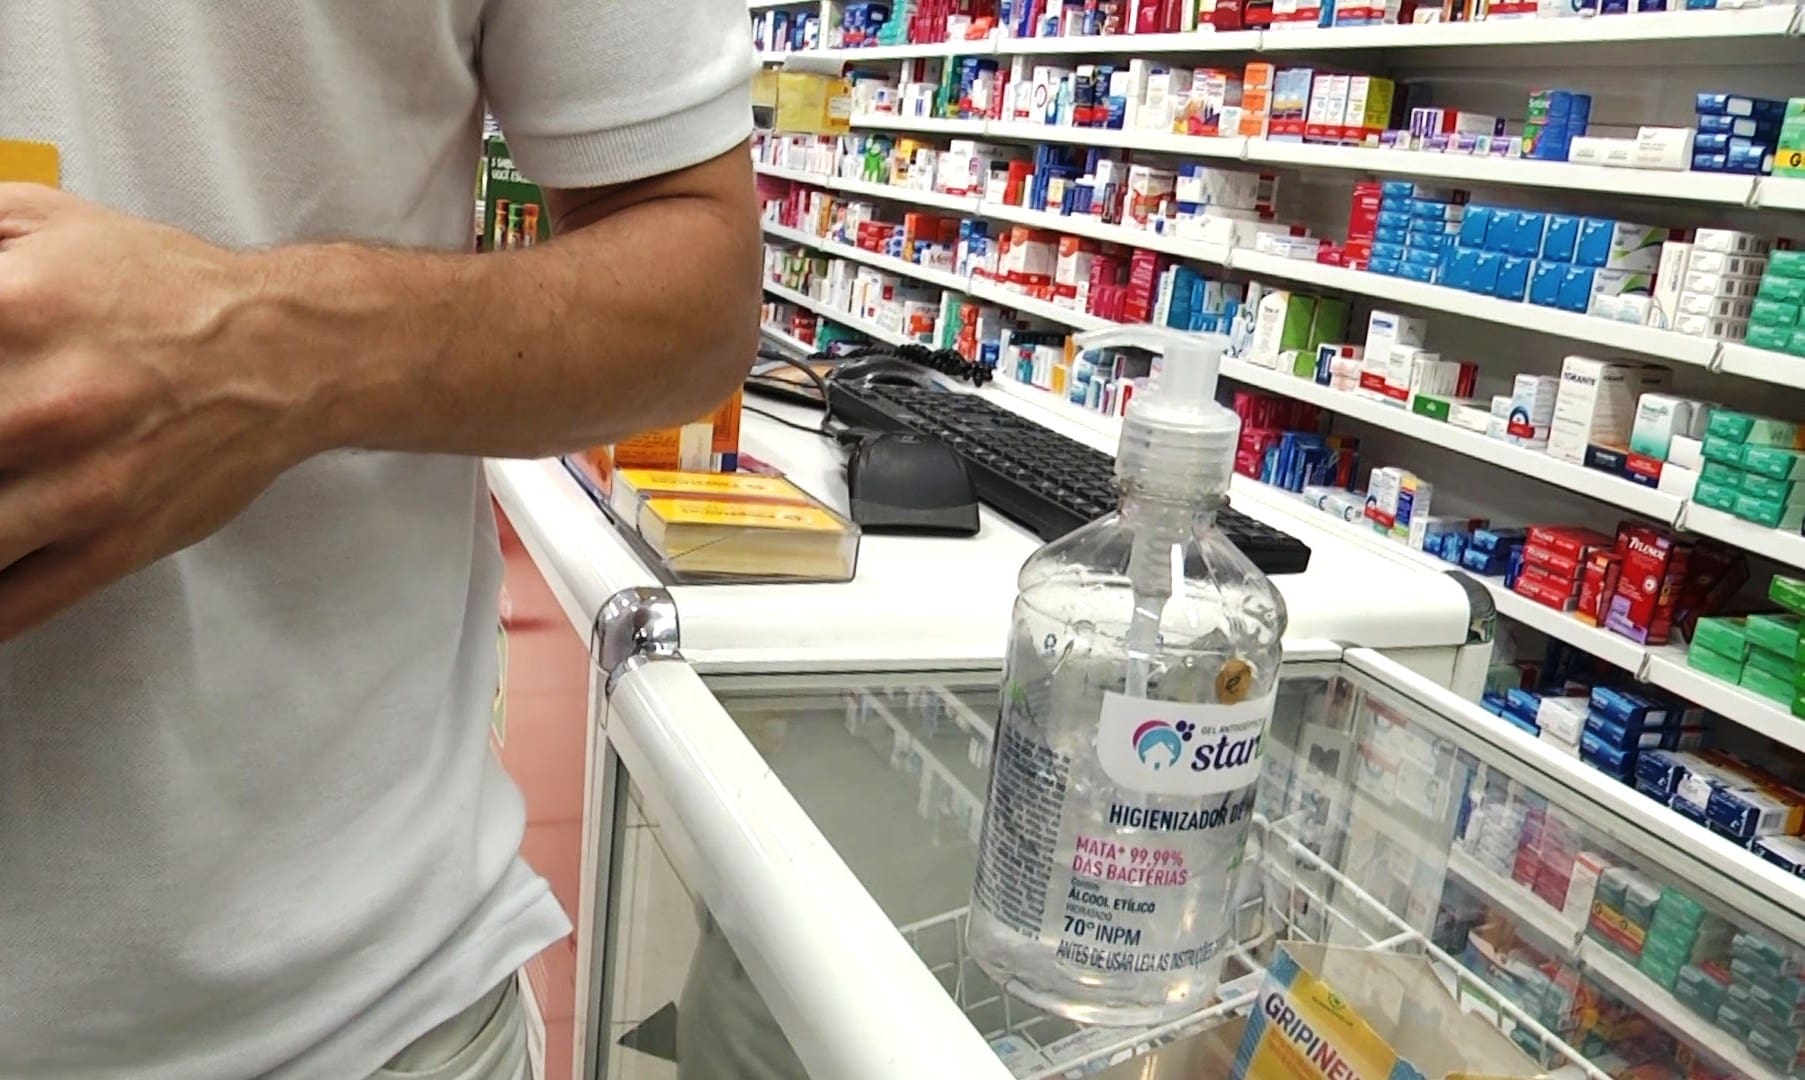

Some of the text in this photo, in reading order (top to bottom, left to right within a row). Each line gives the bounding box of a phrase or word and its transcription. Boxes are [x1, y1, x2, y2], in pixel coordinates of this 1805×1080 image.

[1627, 536, 1667, 561] TYLENOL
[1109, 803, 1227, 831] HIGIENIZADOR
[1072, 855, 1103, 877] DAS
[1114, 898, 1156, 914] ETÍLICO
[1056, 938, 1088, 965] ANTES
[1107, 950, 1134, 972] USAR
[1265, 992, 1360, 1080] GRIPINE
